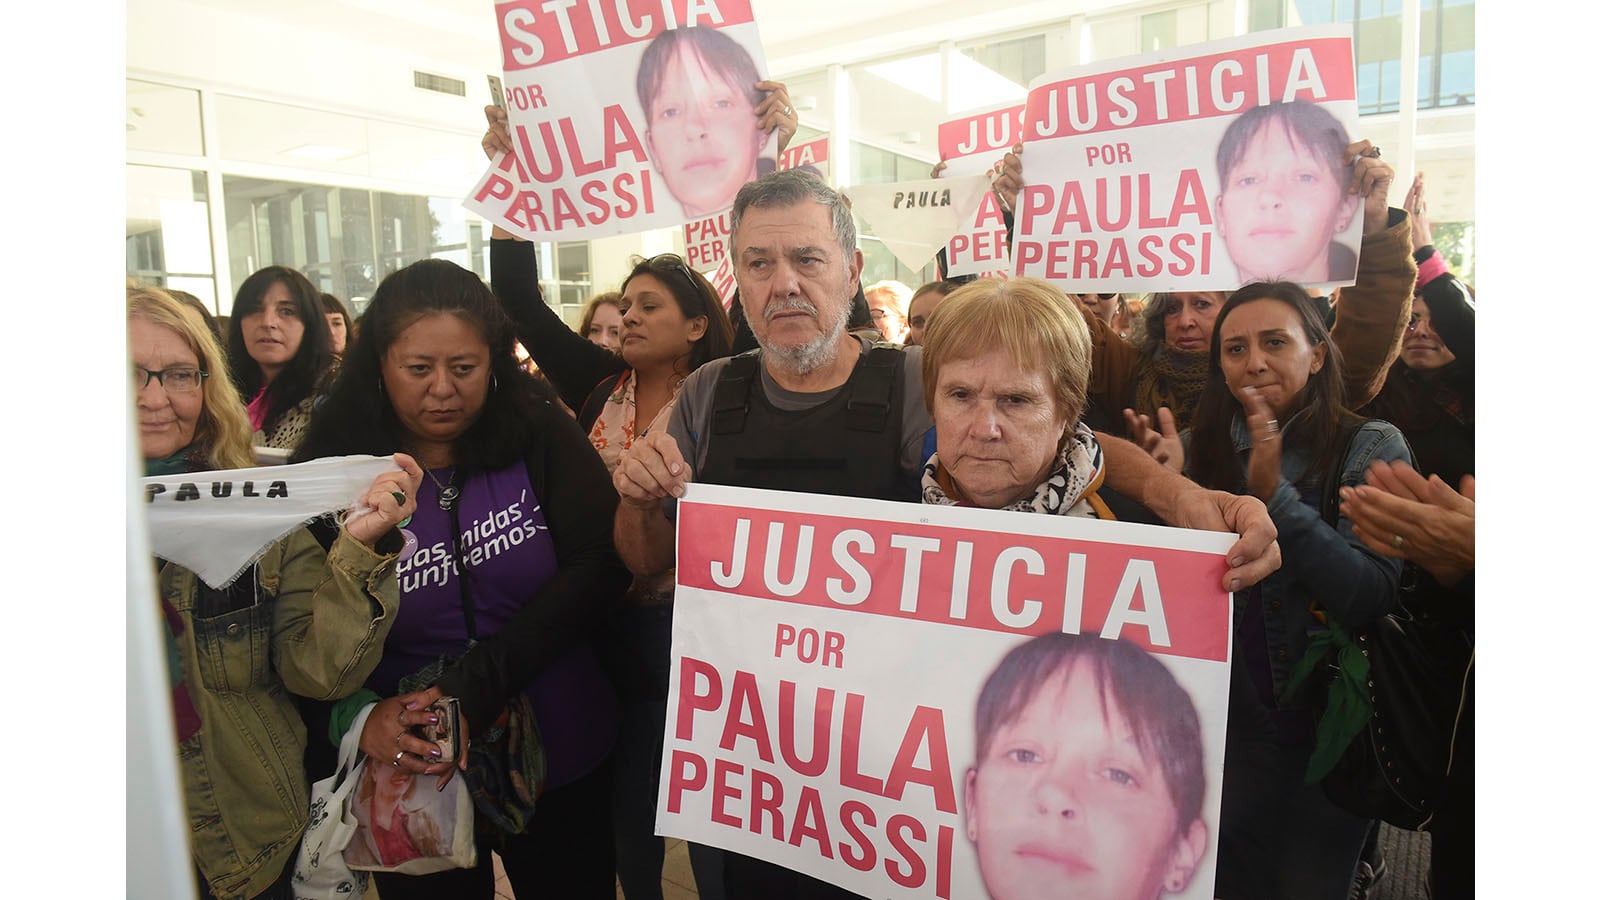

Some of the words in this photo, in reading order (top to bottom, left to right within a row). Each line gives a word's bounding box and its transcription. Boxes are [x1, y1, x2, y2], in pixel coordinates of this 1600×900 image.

[506, 84, 548, 111] POR
[1035, 47, 1327, 137] JUSTICIA
[1086, 143, 1132, 167] POR
[893, 189, 951, 208] PAULA
[1020, 169, 1212, 235] PAULA
[687, 240, 731, 267] PER
[1015, 232, 1211, 279] PERASSI
[145, 481, 288, 502] PAULA
[461, 502, 523, 550] nidas
[710, 518, 1171, 647] JUSTICIA
[774, 623, 845, 668] POR
[675, 656, 958, 815] PAULA
[667, 750, 955, 900] PERASSI
